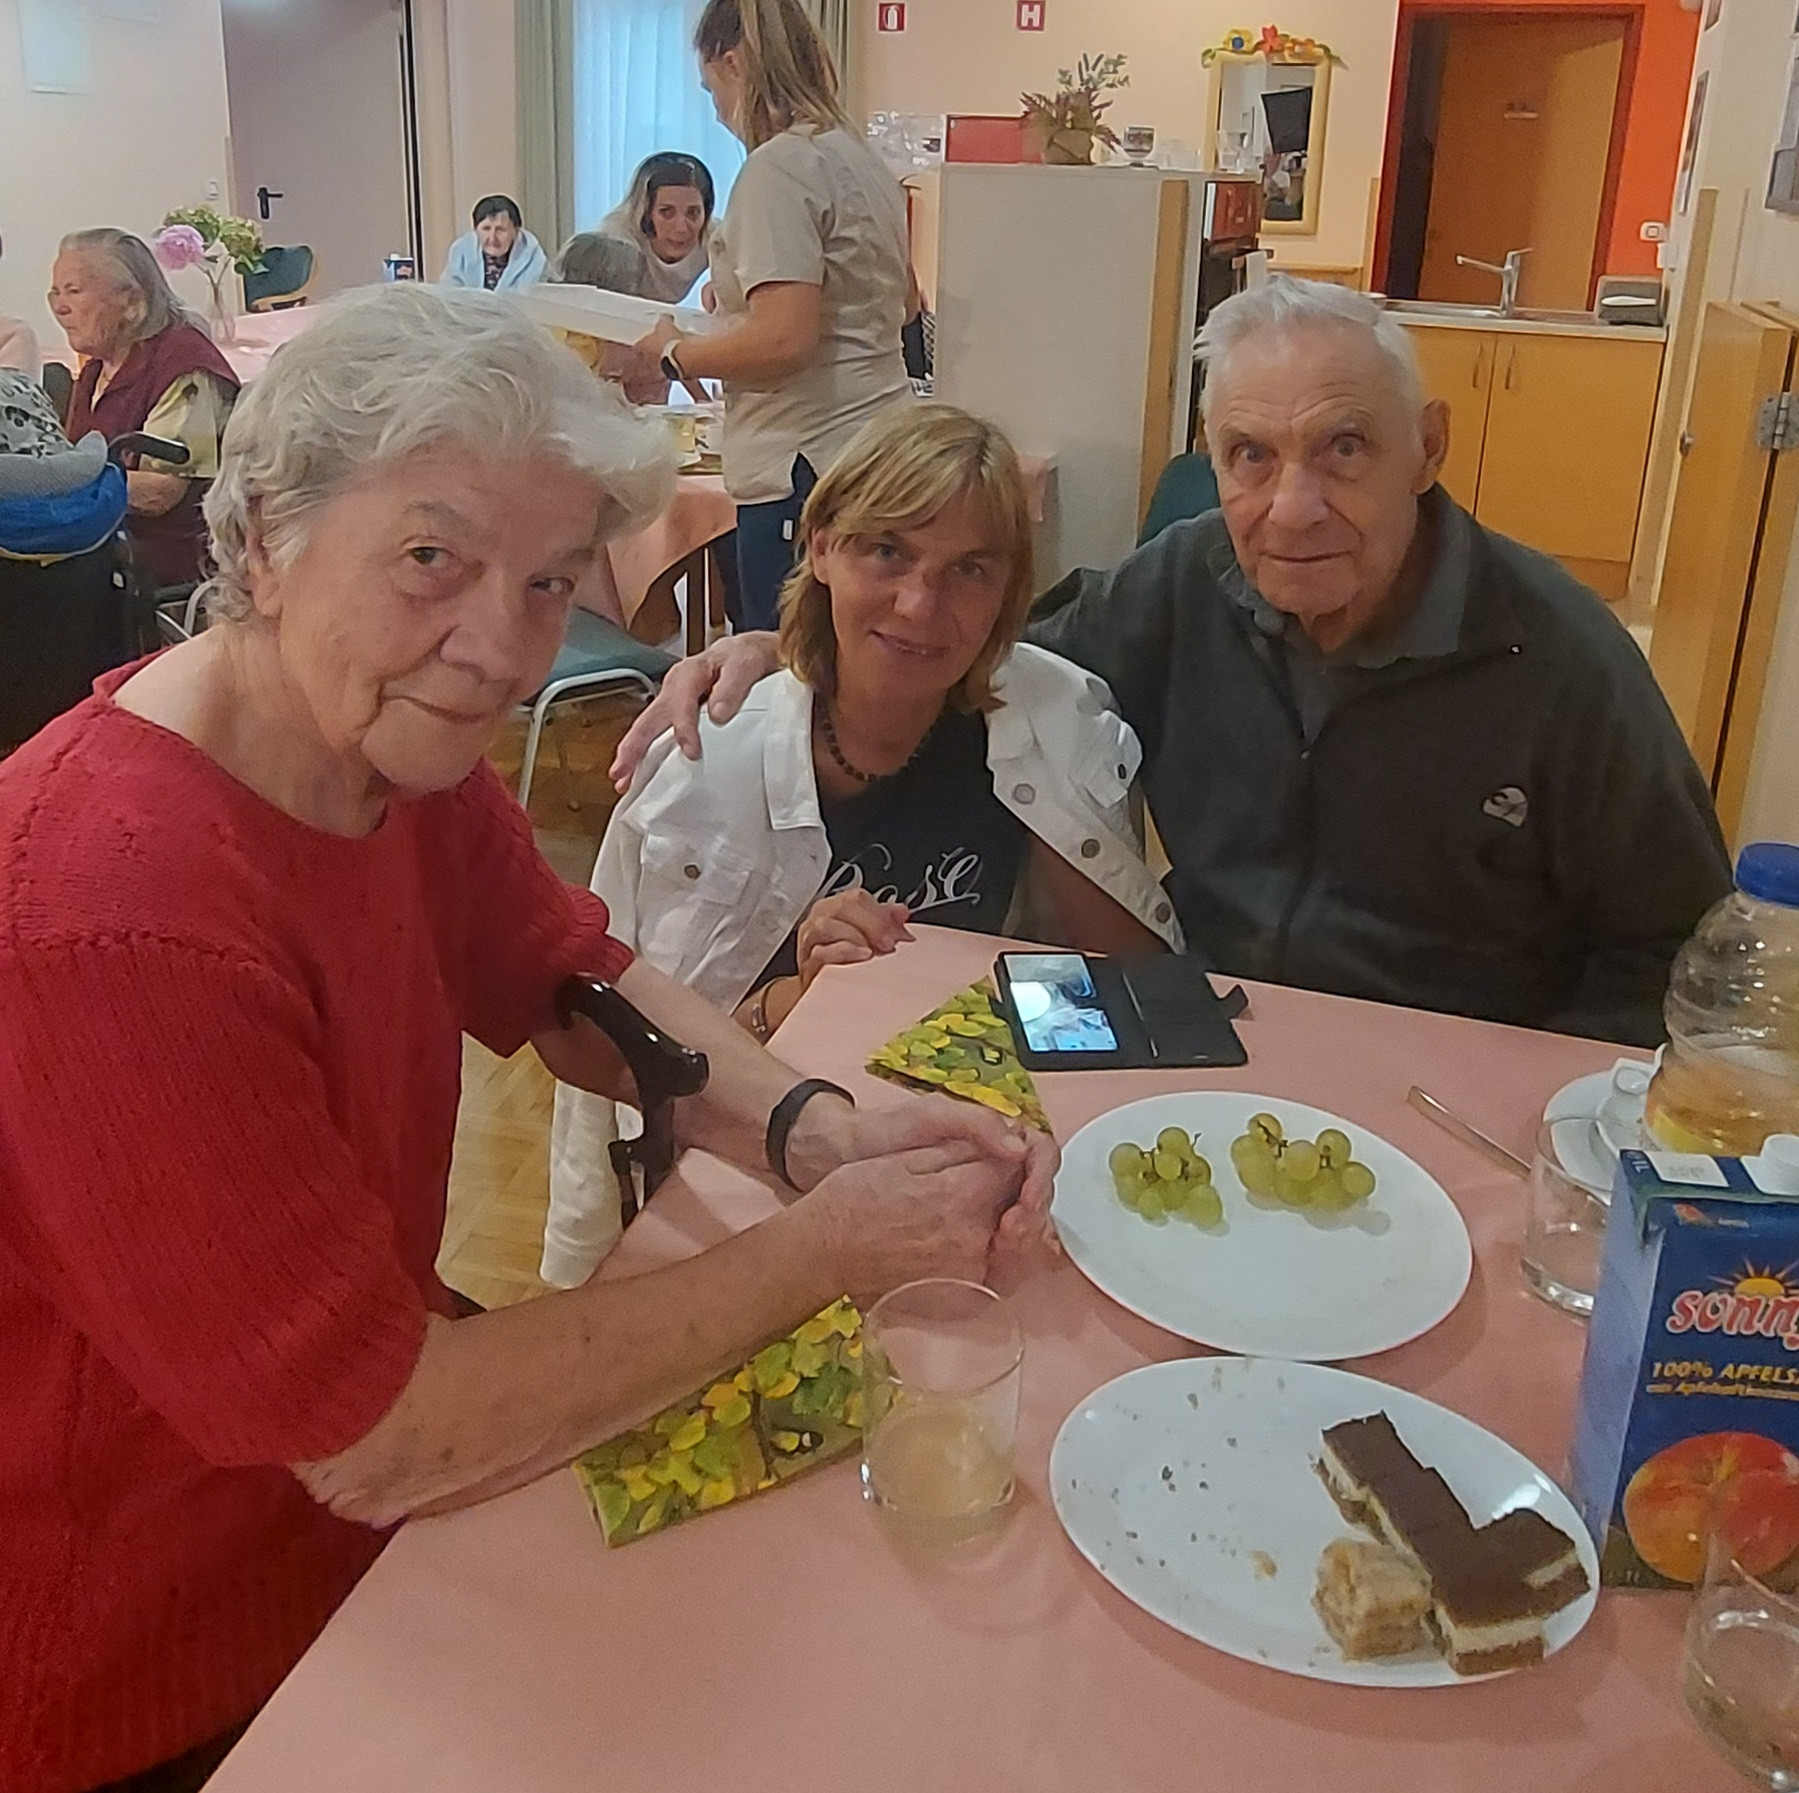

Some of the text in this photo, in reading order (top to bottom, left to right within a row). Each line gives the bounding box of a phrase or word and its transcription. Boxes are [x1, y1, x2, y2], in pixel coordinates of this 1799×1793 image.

[1021, 3, 1041, 28] H
[1652, 1361, 1799, 1385] 100% APFELS
